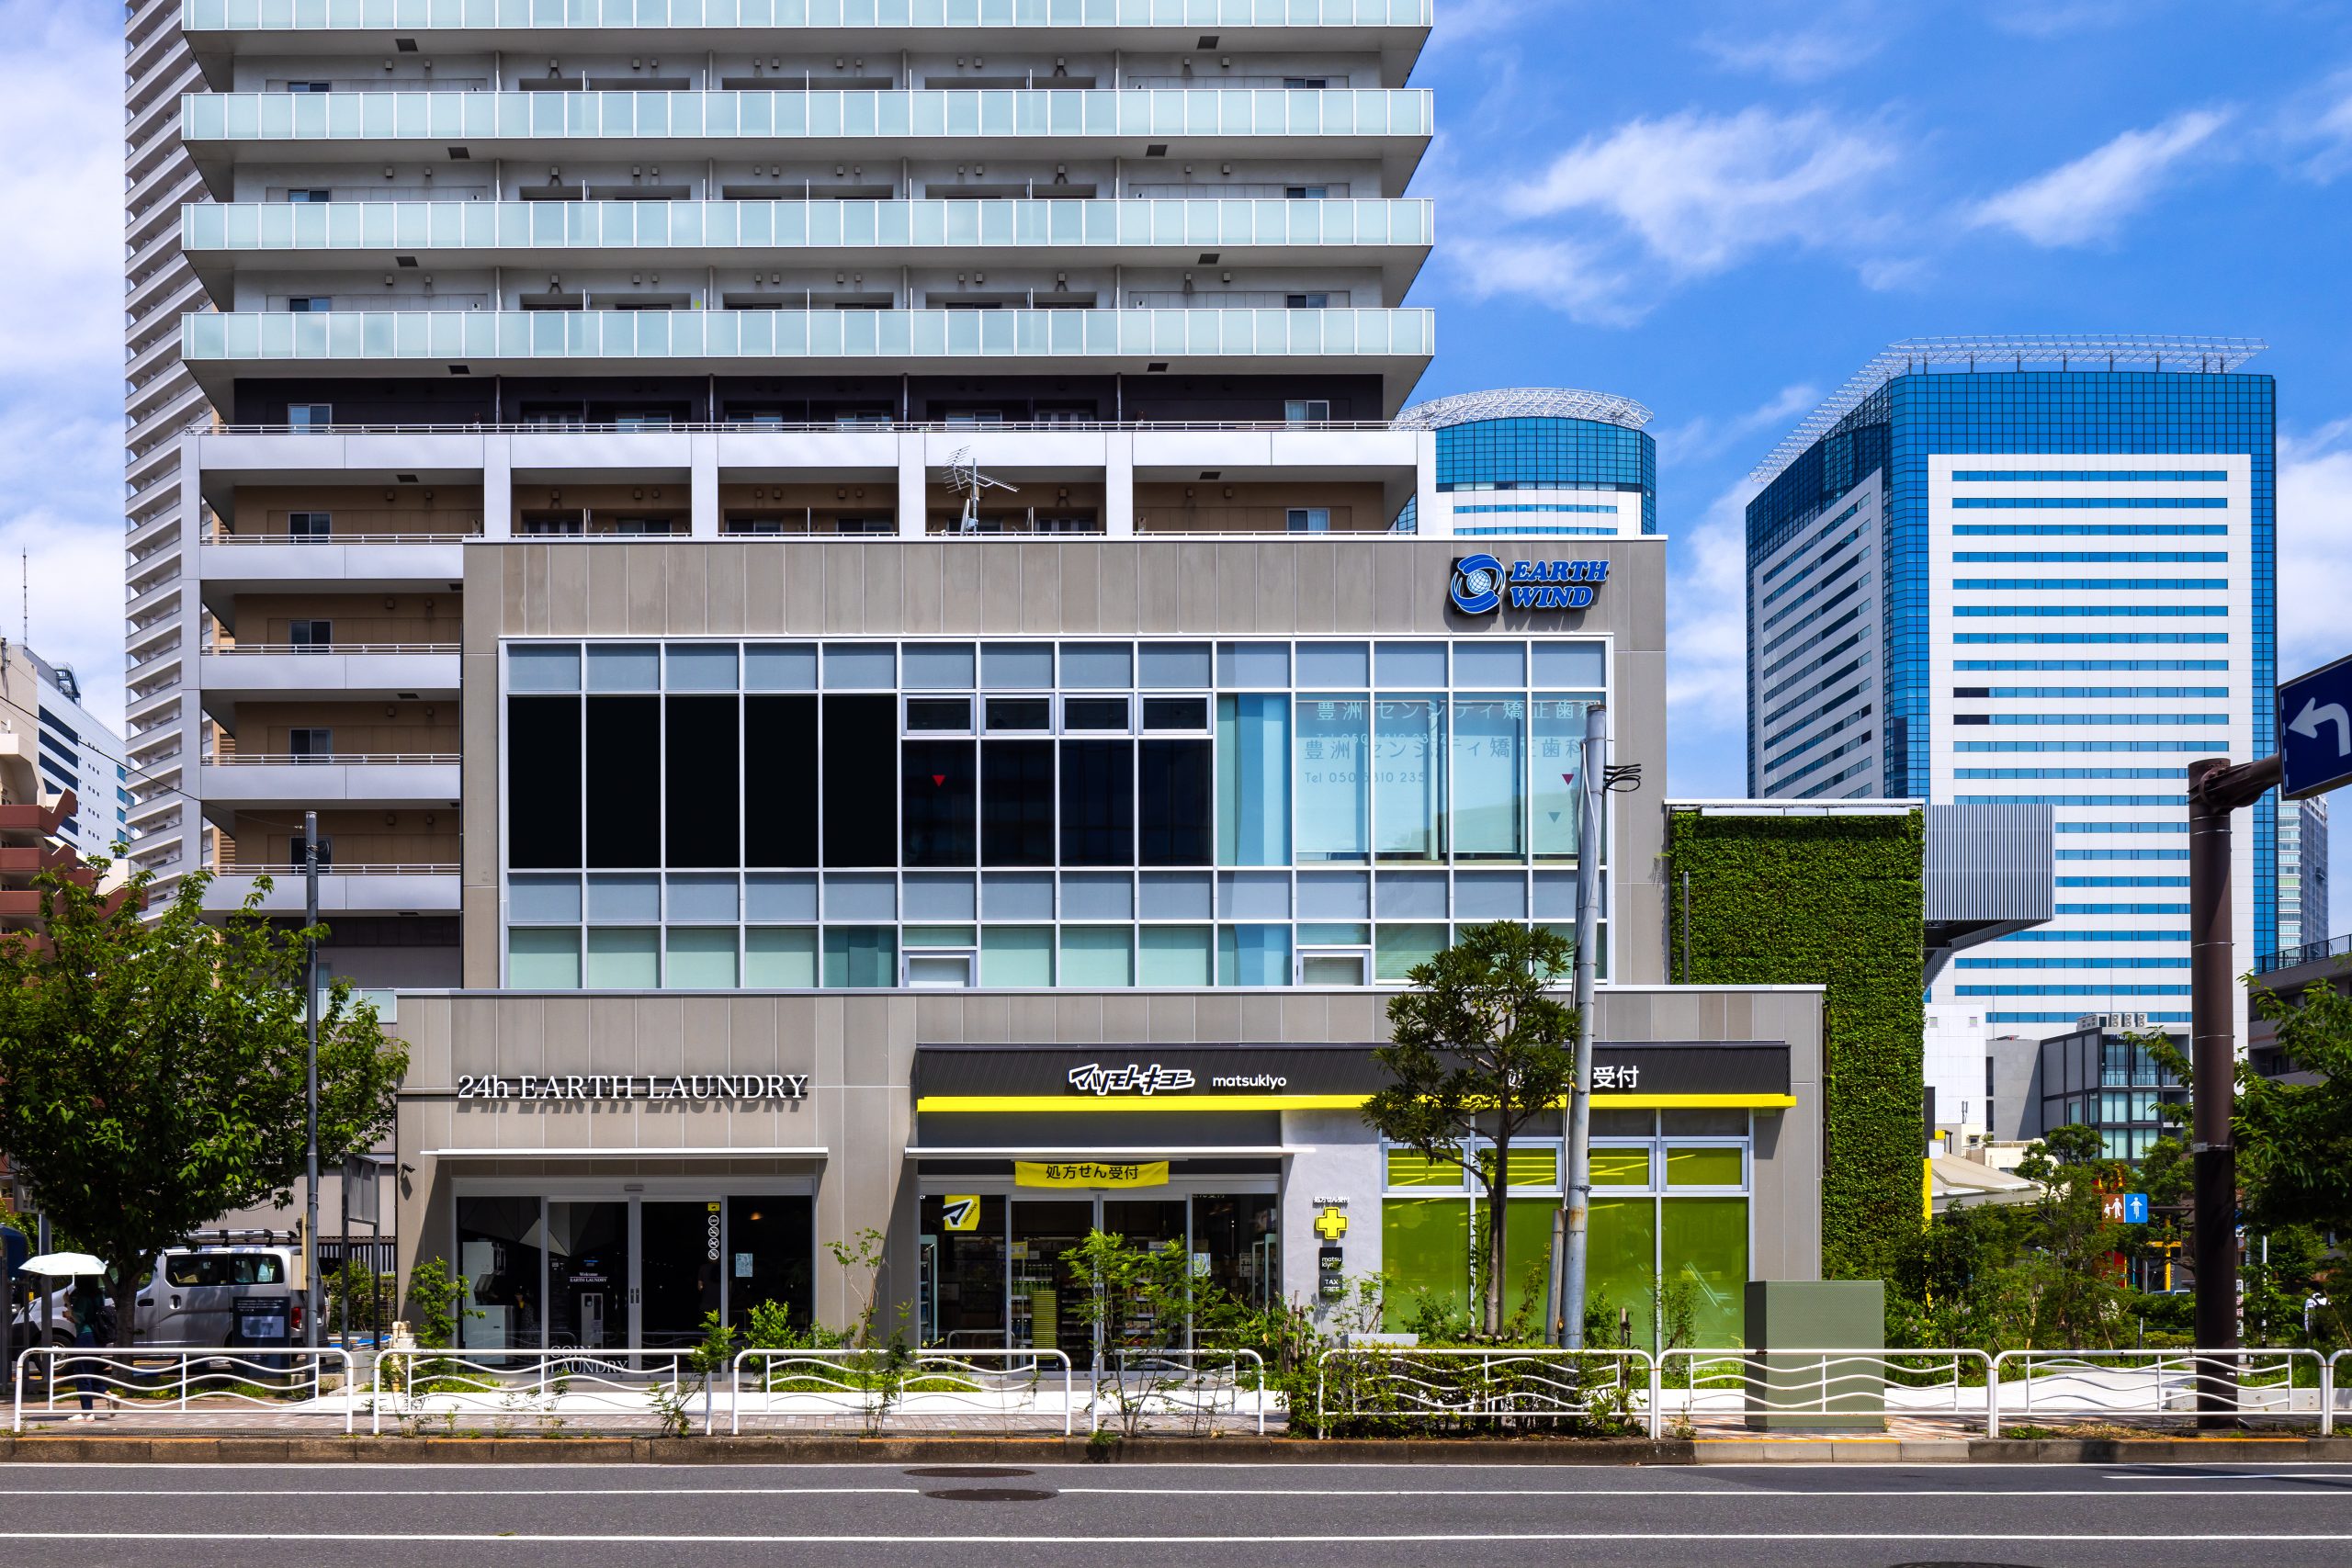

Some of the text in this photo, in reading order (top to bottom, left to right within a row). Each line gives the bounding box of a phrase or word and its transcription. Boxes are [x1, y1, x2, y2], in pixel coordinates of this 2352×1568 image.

[1510, 560, 1610, 581] EARTH
[1510, 586, 1594, 607] WIND
[458, 1074, 808, 1100] 24h EARTH LAUNDRY
[1069, 1064, 1195, 1095] マツモトキヨシ
[1212, 1074, 1287, 1089] matsukiyo
[1046, 1164, 1139, 1180] 処方せん受付
